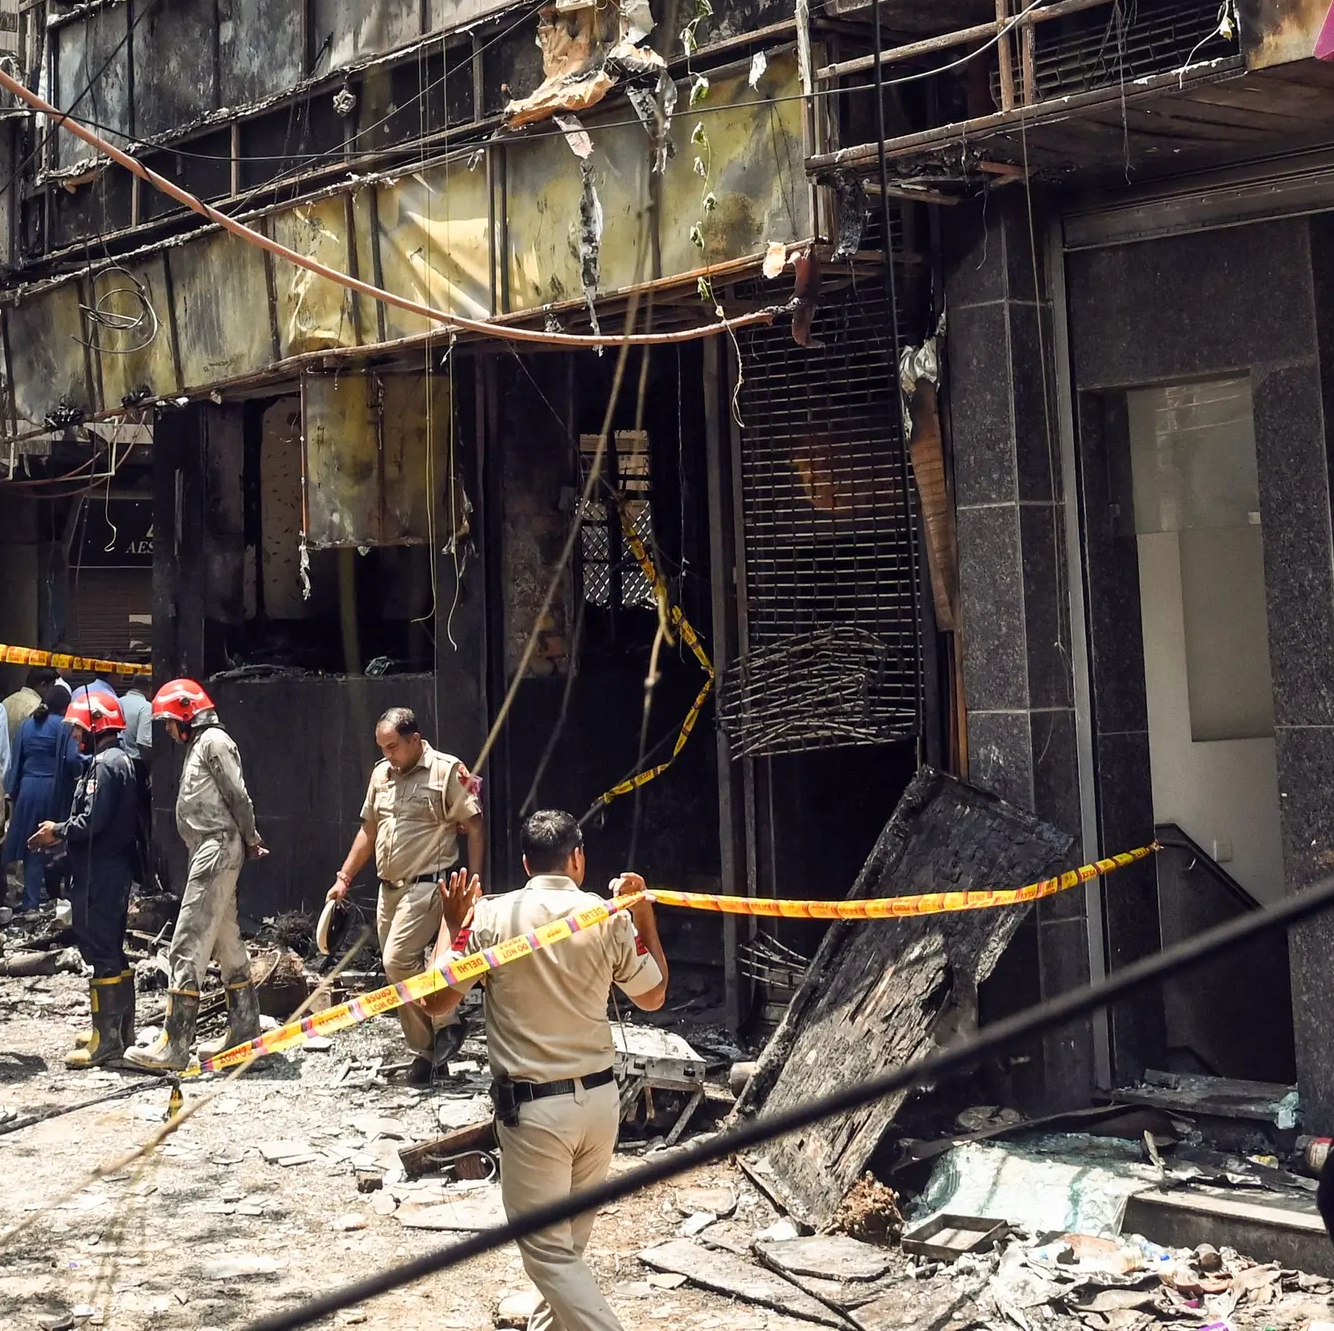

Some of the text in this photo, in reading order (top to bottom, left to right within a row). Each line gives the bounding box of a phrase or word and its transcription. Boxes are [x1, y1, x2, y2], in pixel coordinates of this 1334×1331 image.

[580, 906, 604, 921] DELHI
[502, 946, 518, 959] NOT
[517, 942, 529, 953] DO
[458, 957, 483, 974] DELHI
[365, 989, 392, 1005] CROSS
[370, 996, 399, 1013] DO NOT
